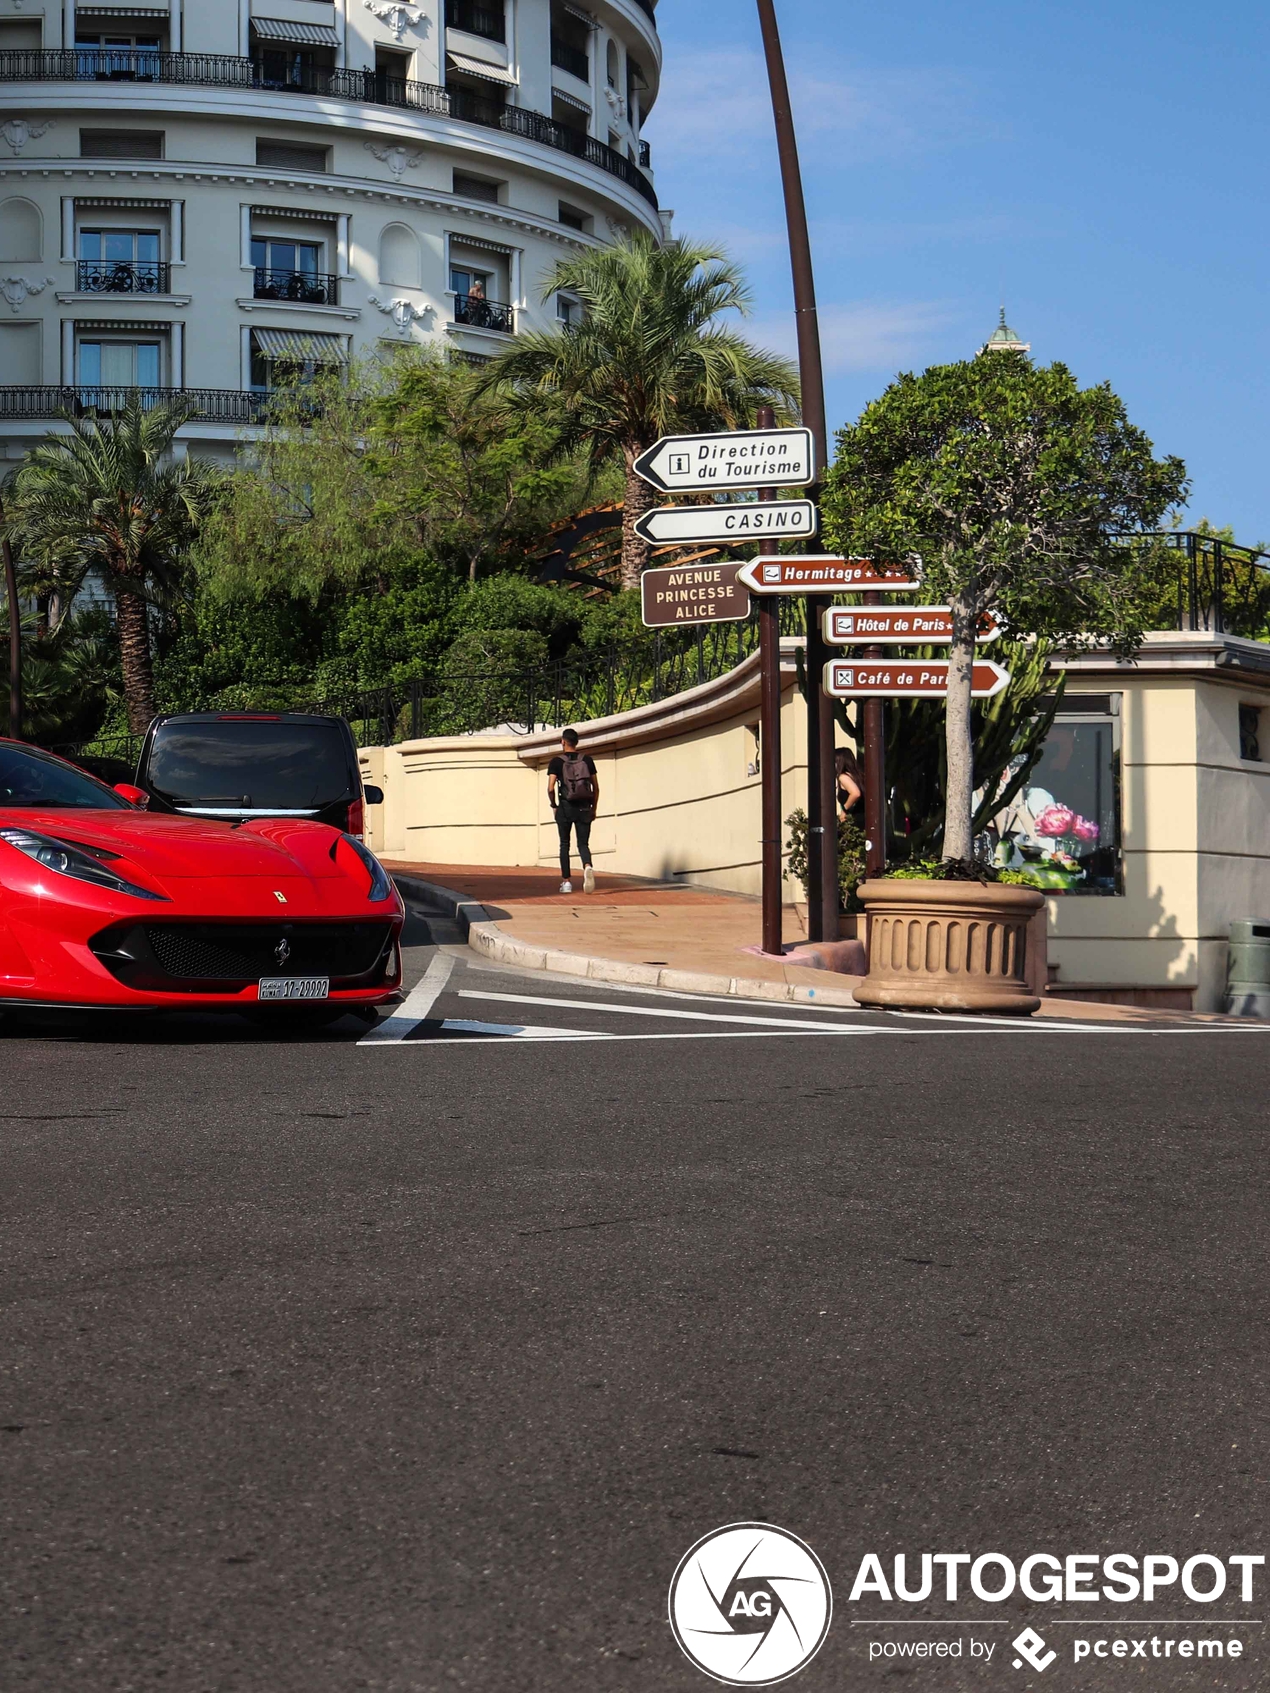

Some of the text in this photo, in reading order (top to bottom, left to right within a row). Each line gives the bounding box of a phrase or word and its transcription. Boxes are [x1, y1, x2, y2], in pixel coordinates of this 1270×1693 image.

[698, 442, 787, 460] Direction
[698, 460, 801, 478] du Tourisme
[725, 511, 802, 529] CASINO
[668, 570, 721, 586] AVENUE
[784, 566, 862, 582] Hermitage
[656, 585, 734, 604] PRINCESSE
[675, 604, 716, 618] ALICE
[856, 618, 945, 631] Hôtel de Paris
[857, 672, 949, 685] Café de Pari
